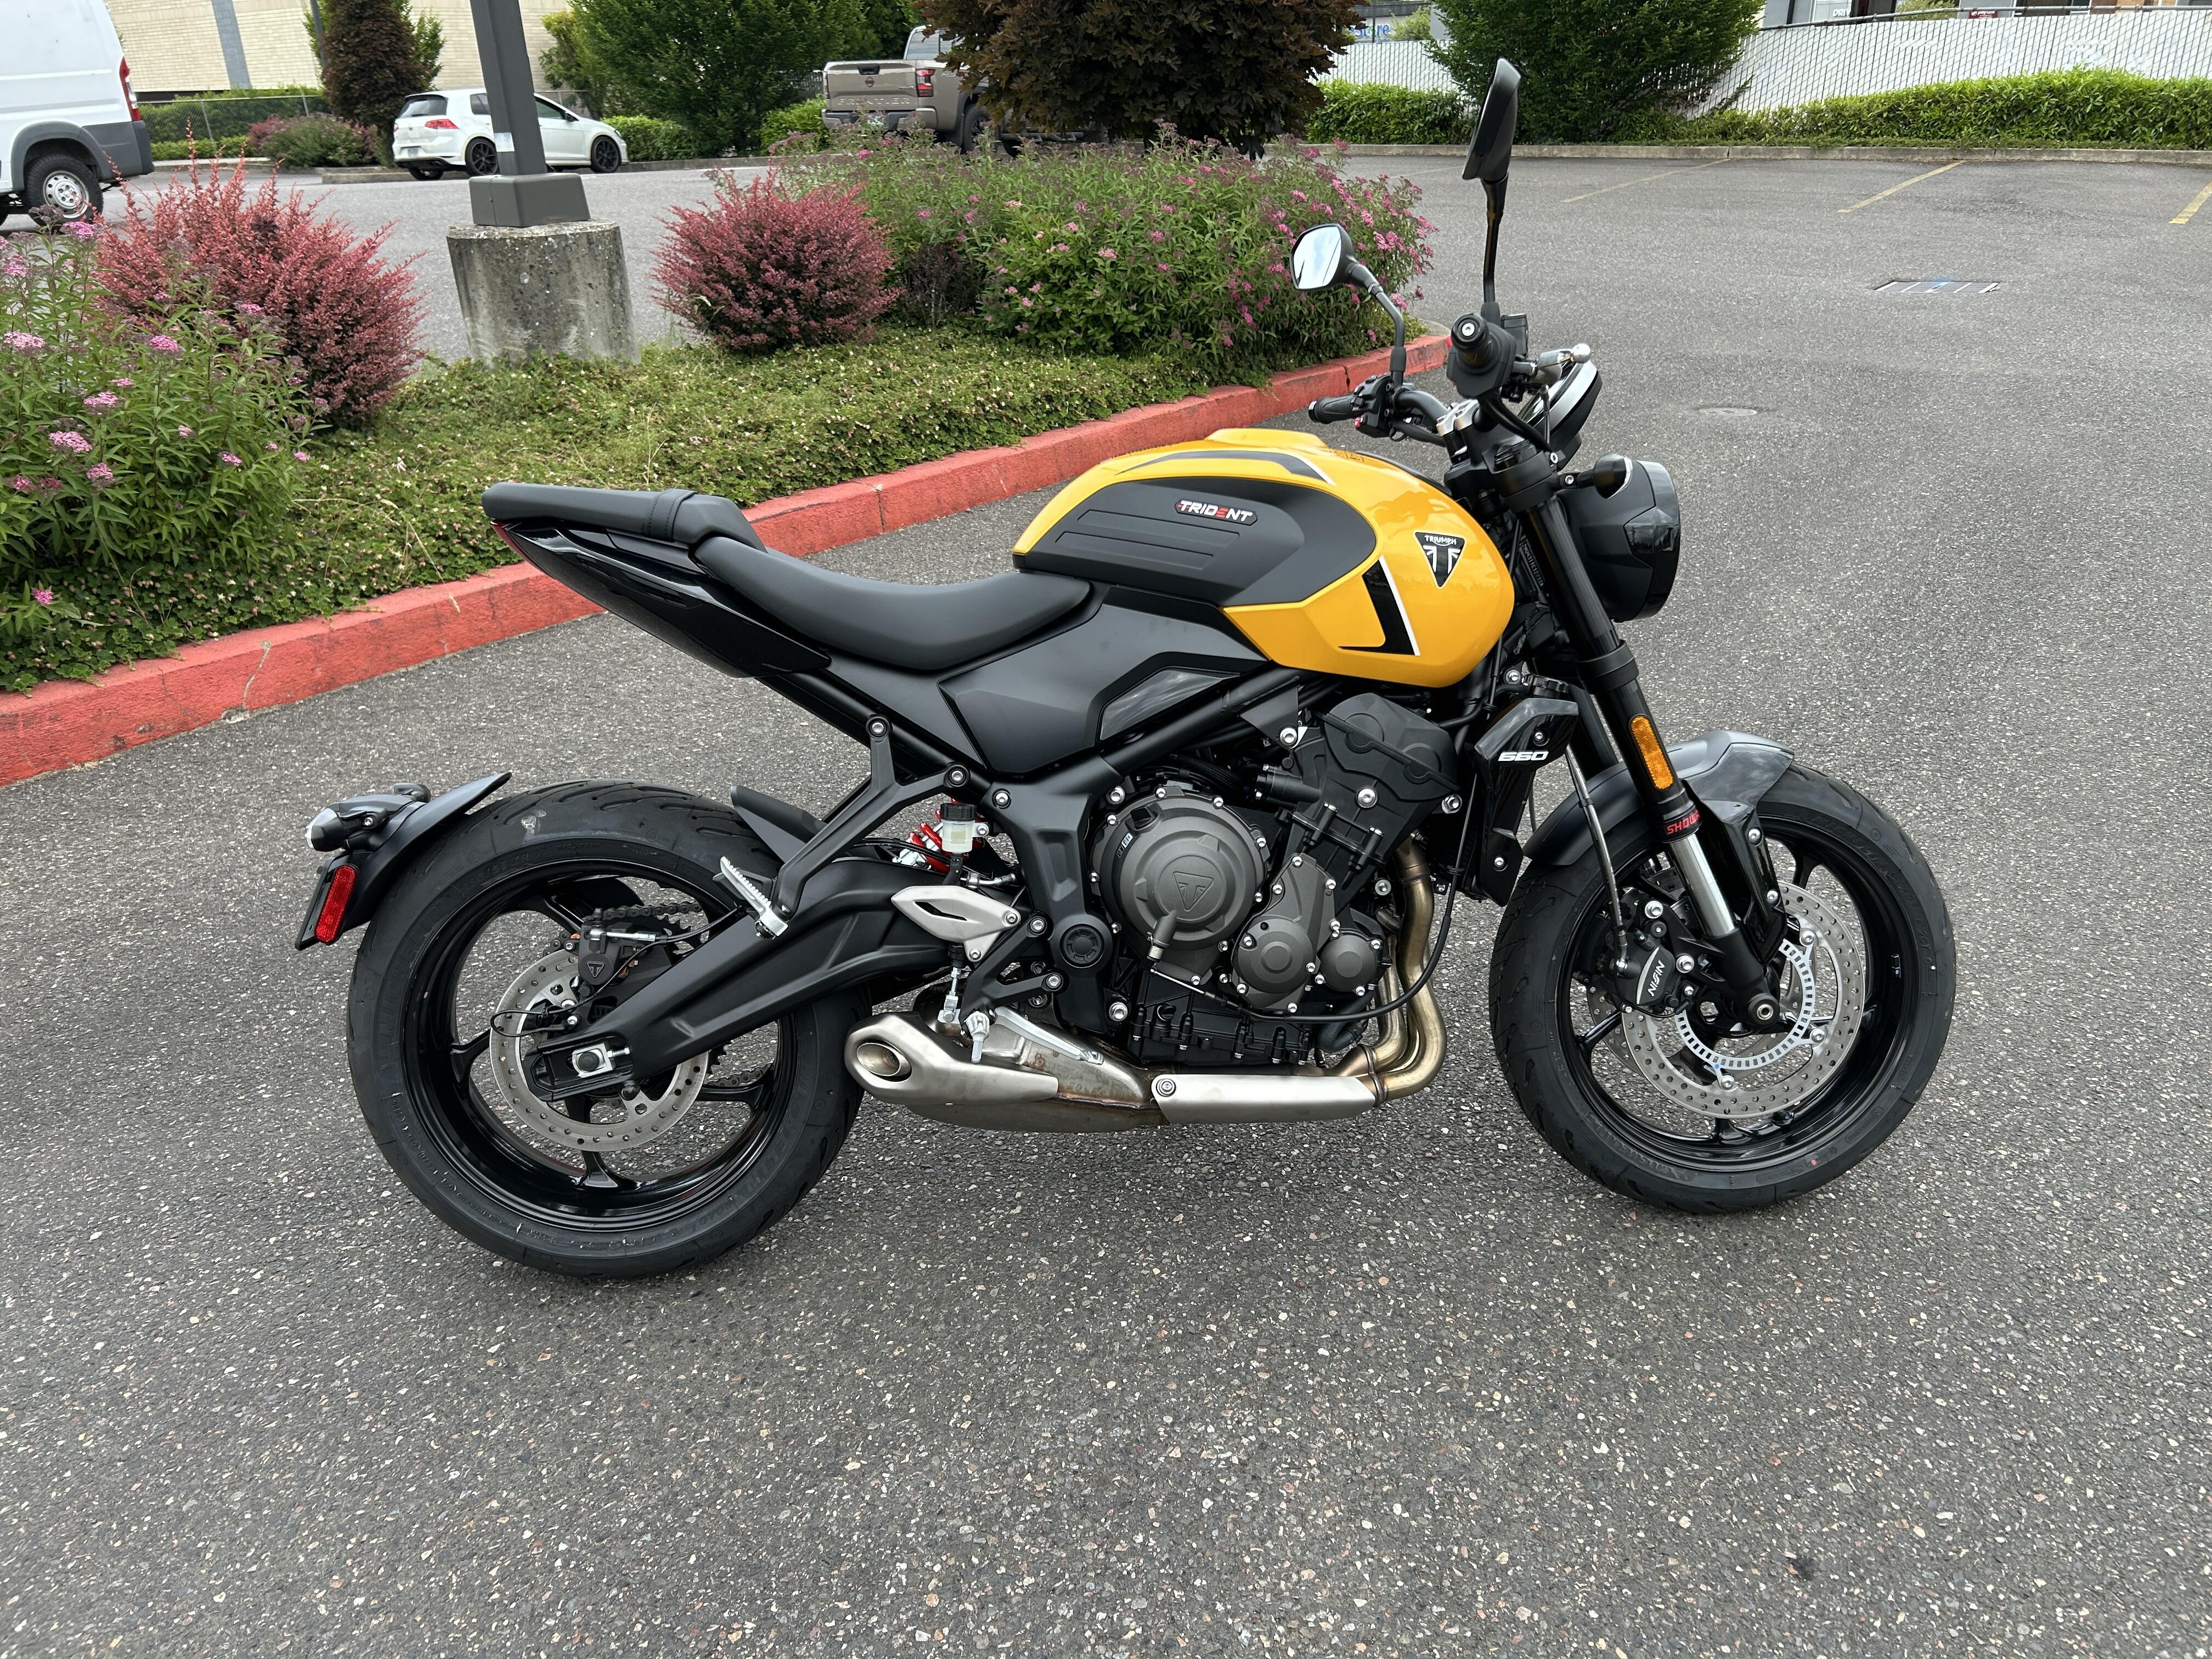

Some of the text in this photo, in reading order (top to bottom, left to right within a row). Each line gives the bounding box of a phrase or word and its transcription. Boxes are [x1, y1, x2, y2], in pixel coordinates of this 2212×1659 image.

[1180, 500, 1253, 521] TRIDENT
[1424, 535, 1457, 545] TRIUMPH
[1498, 752, 1549, 761] 660
[1667, 810, 1700, 834] SHOWA
[1647, 960, 1665, 997] NISSIN
